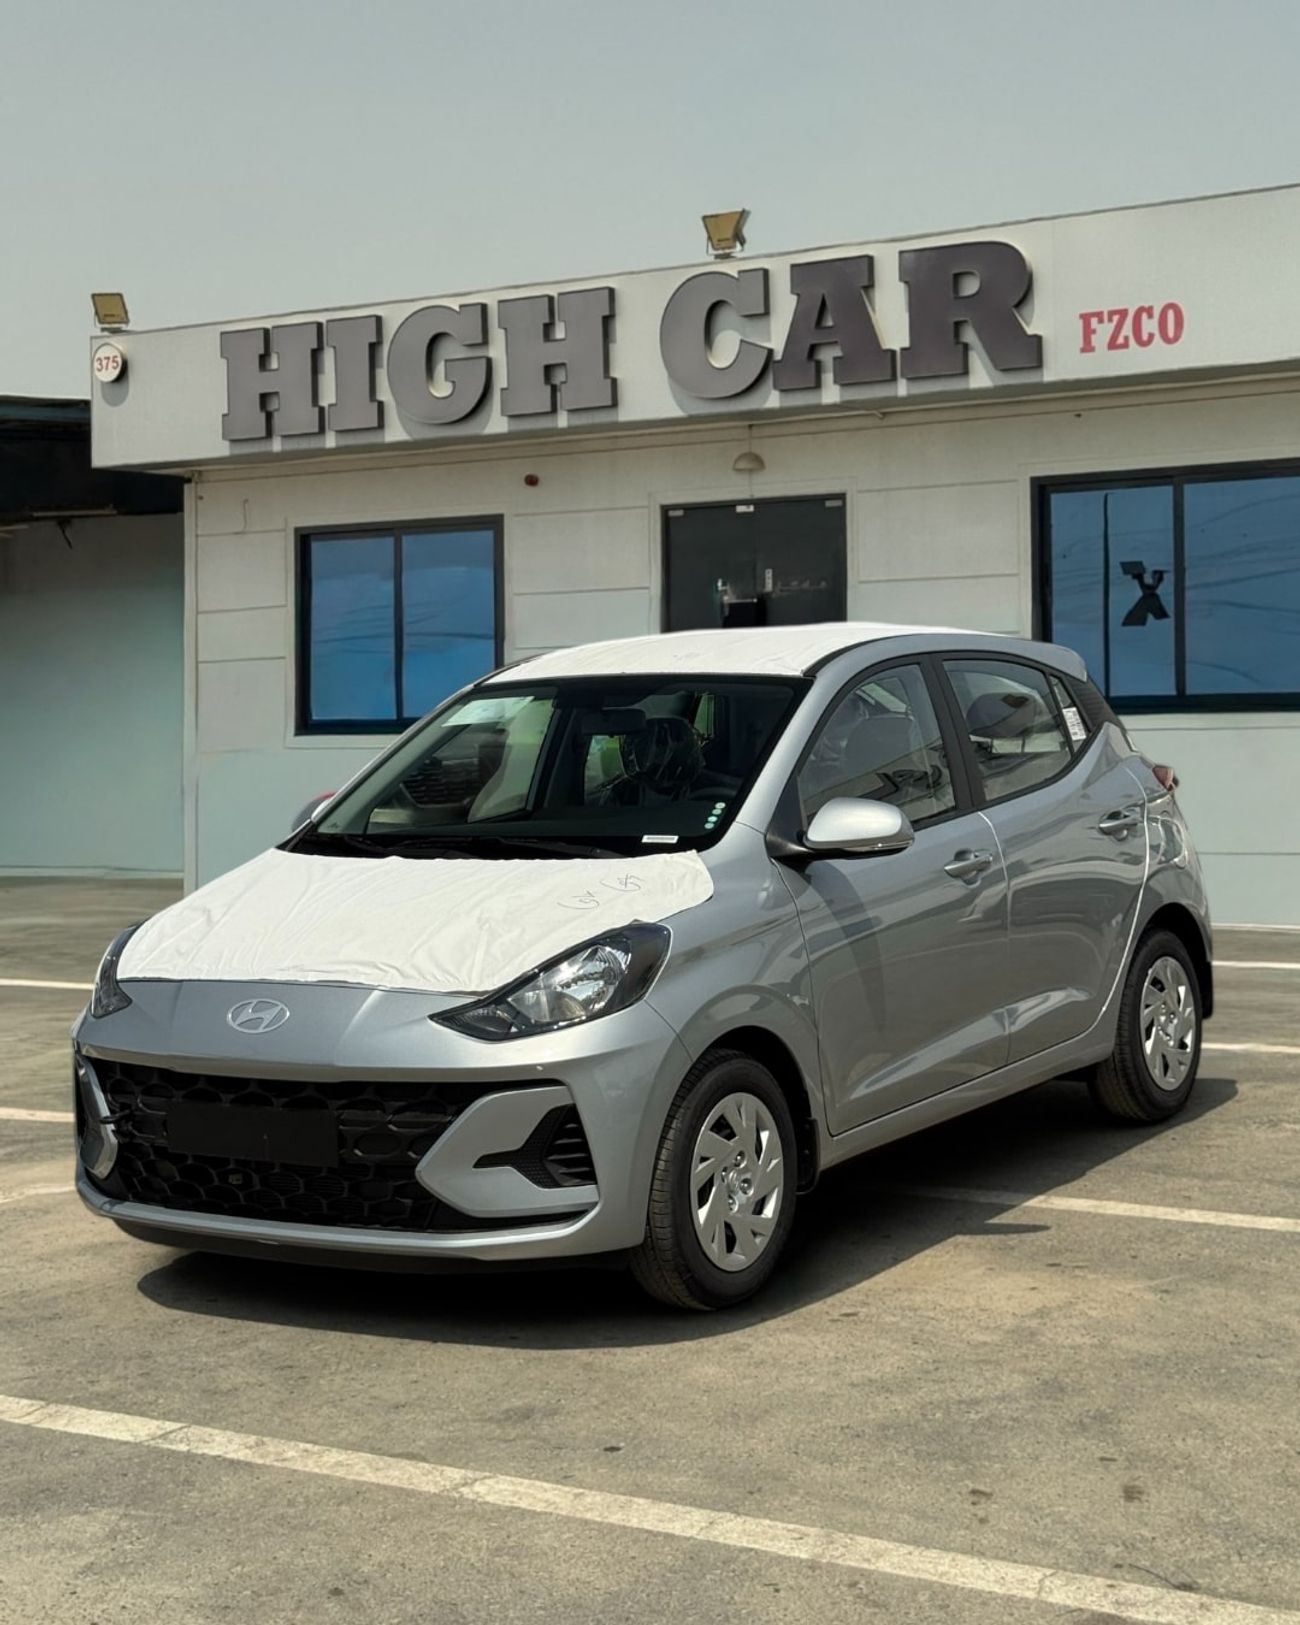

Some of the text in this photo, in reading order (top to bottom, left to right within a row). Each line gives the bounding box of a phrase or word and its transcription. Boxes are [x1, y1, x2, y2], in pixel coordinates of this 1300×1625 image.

[220, 241, 1042, 441] HIGH CAR
[1079, 302, 1184, 353] FZCO
[95, 355, 119, 372] 375
